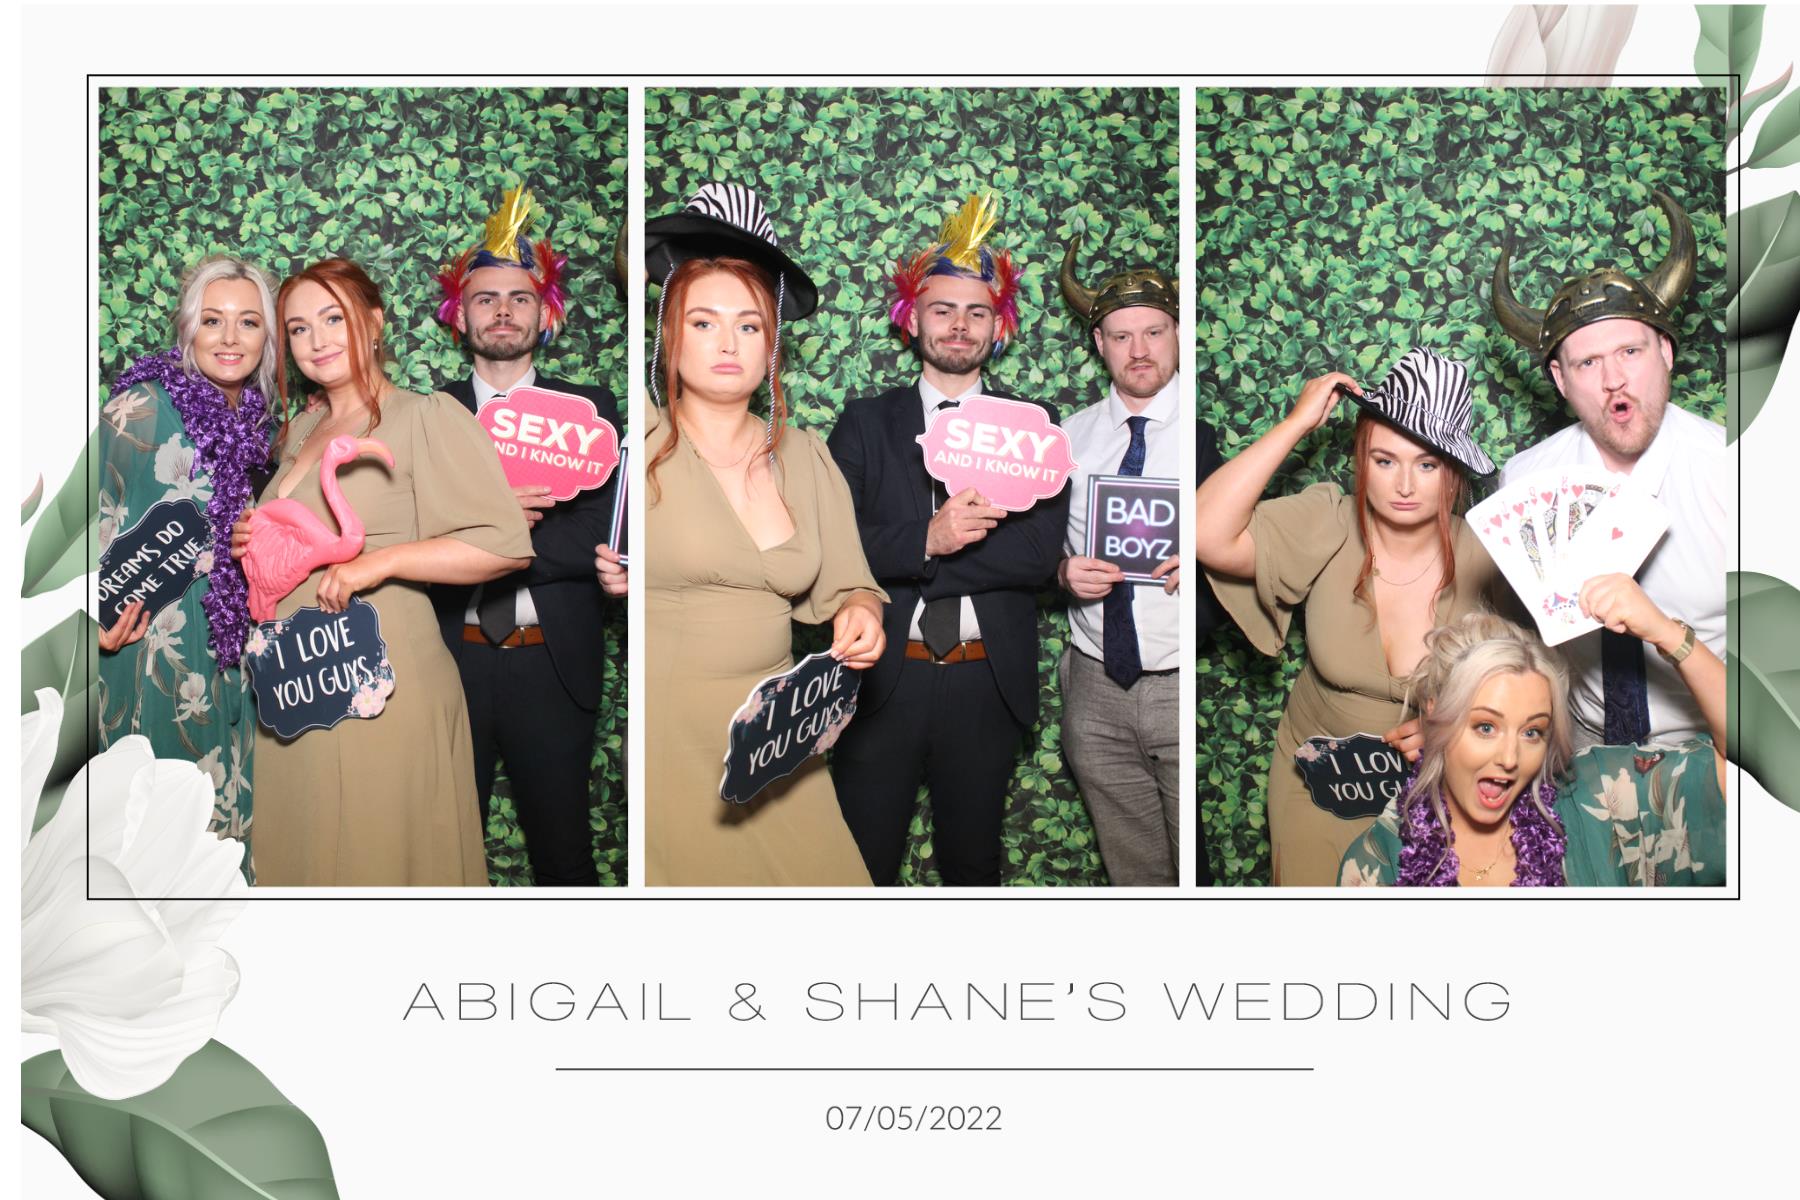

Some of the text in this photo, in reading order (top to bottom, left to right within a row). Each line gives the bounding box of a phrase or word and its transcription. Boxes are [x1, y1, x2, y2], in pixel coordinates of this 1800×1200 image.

[490, 408, 605, 456] SEXY
[943, 418, 1058, 464] SEXY
[494, 441, 604, 475] ND I KNOW IT
[934, 450, 1059, 483] AND I KNOW IT
[1106, 496, 1175, 527] BAD
[155, 521, 184, 545] DO
[1105, 535, 1173, 560] BOYZ
[158, 537, 204, 575] TRUE
[275, 616, 355, 670] I LOVE
[272, 656, 374, 710] YOU GUYS
[766, 663, 844, 731] I LOVE
[750, 696, 844, 775] YOU GUYS
[1329, 751, 1402, 776] I LOV
[1328, 781, 1374, 801] YOU
